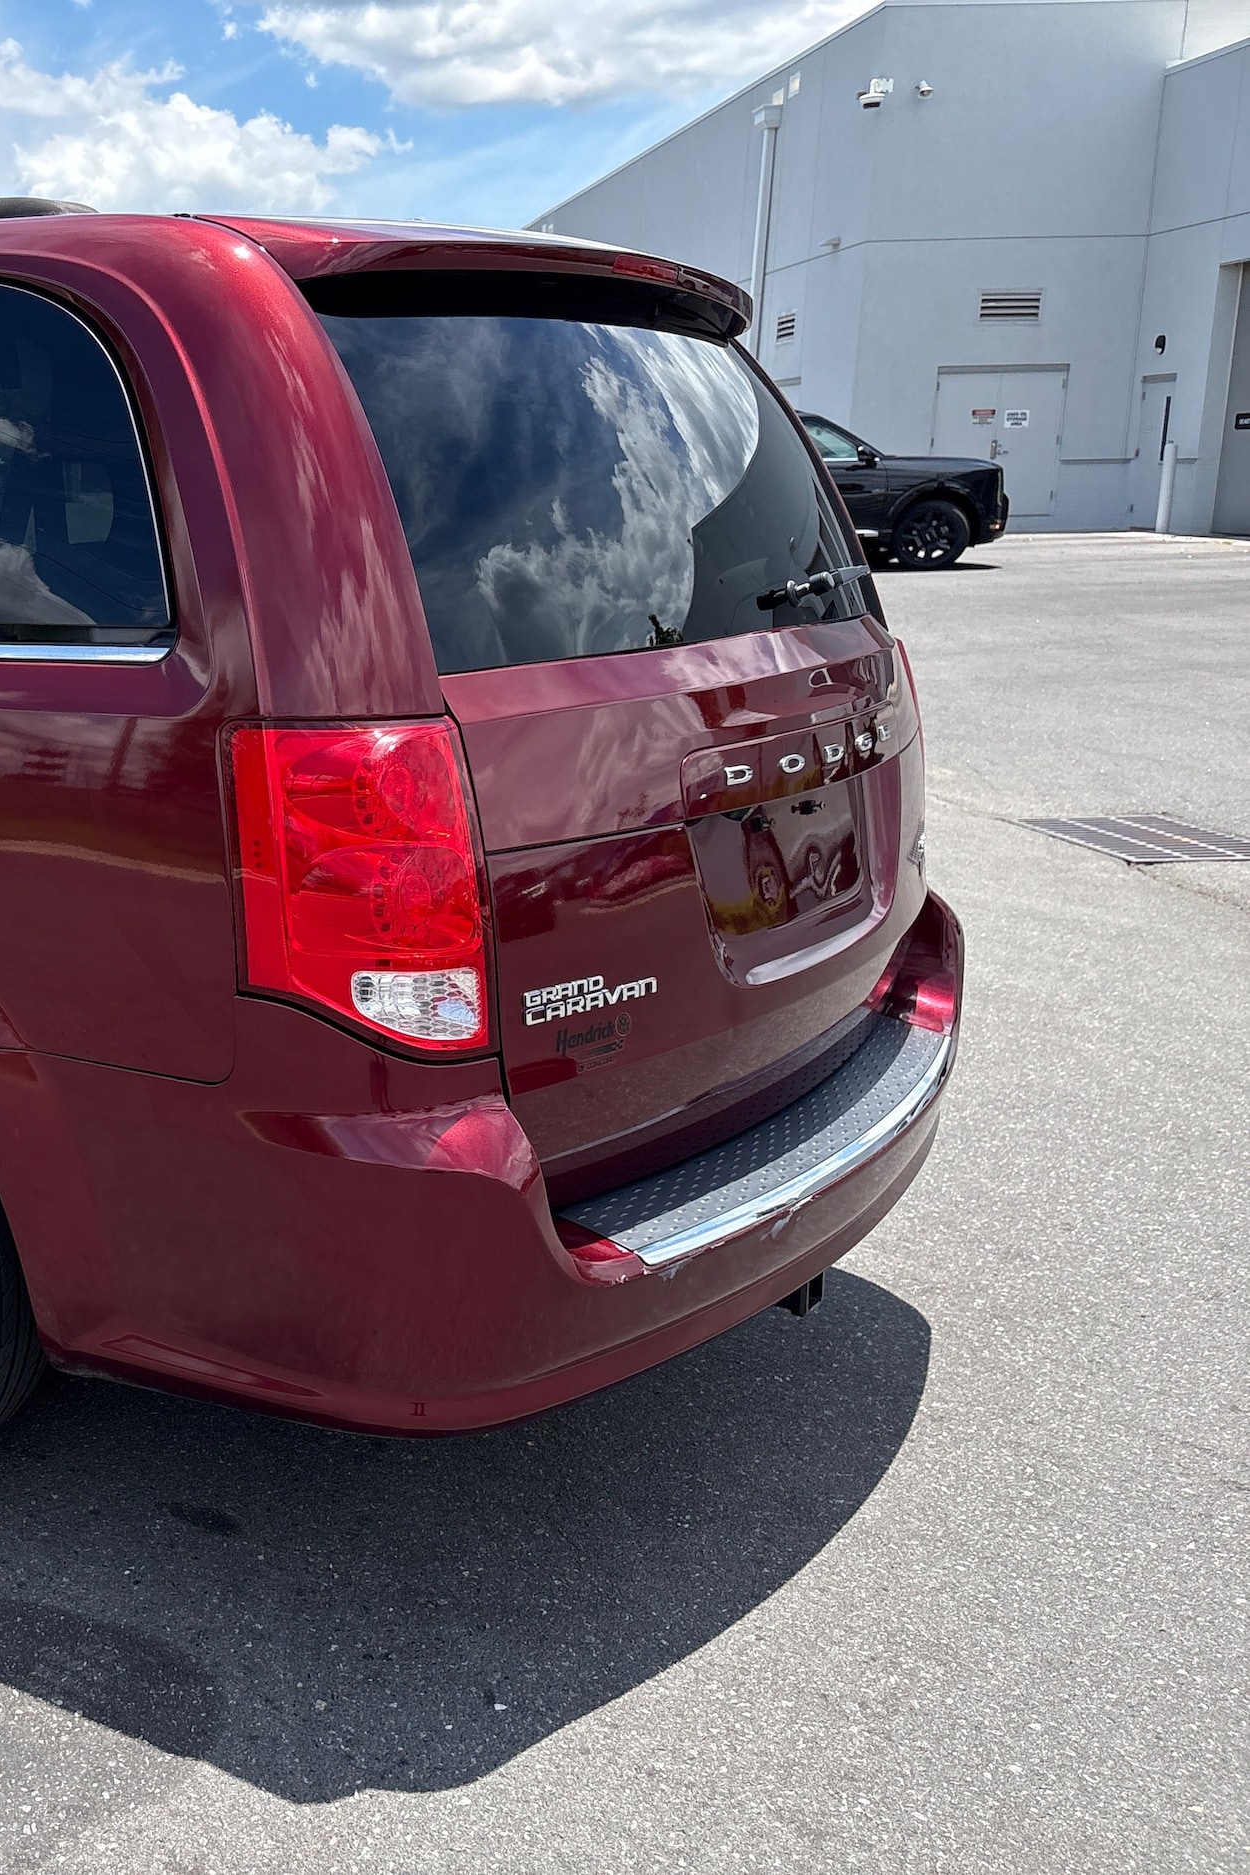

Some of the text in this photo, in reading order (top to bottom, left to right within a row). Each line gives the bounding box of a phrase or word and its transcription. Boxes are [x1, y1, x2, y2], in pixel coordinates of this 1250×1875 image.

[724, 724, 891, 786] DODGE
[523, 975, 604, 1008] GRAND
[525, 976, 658, 1026] CARAVAN
[555, 1019, 616, 1058] Hendrick
